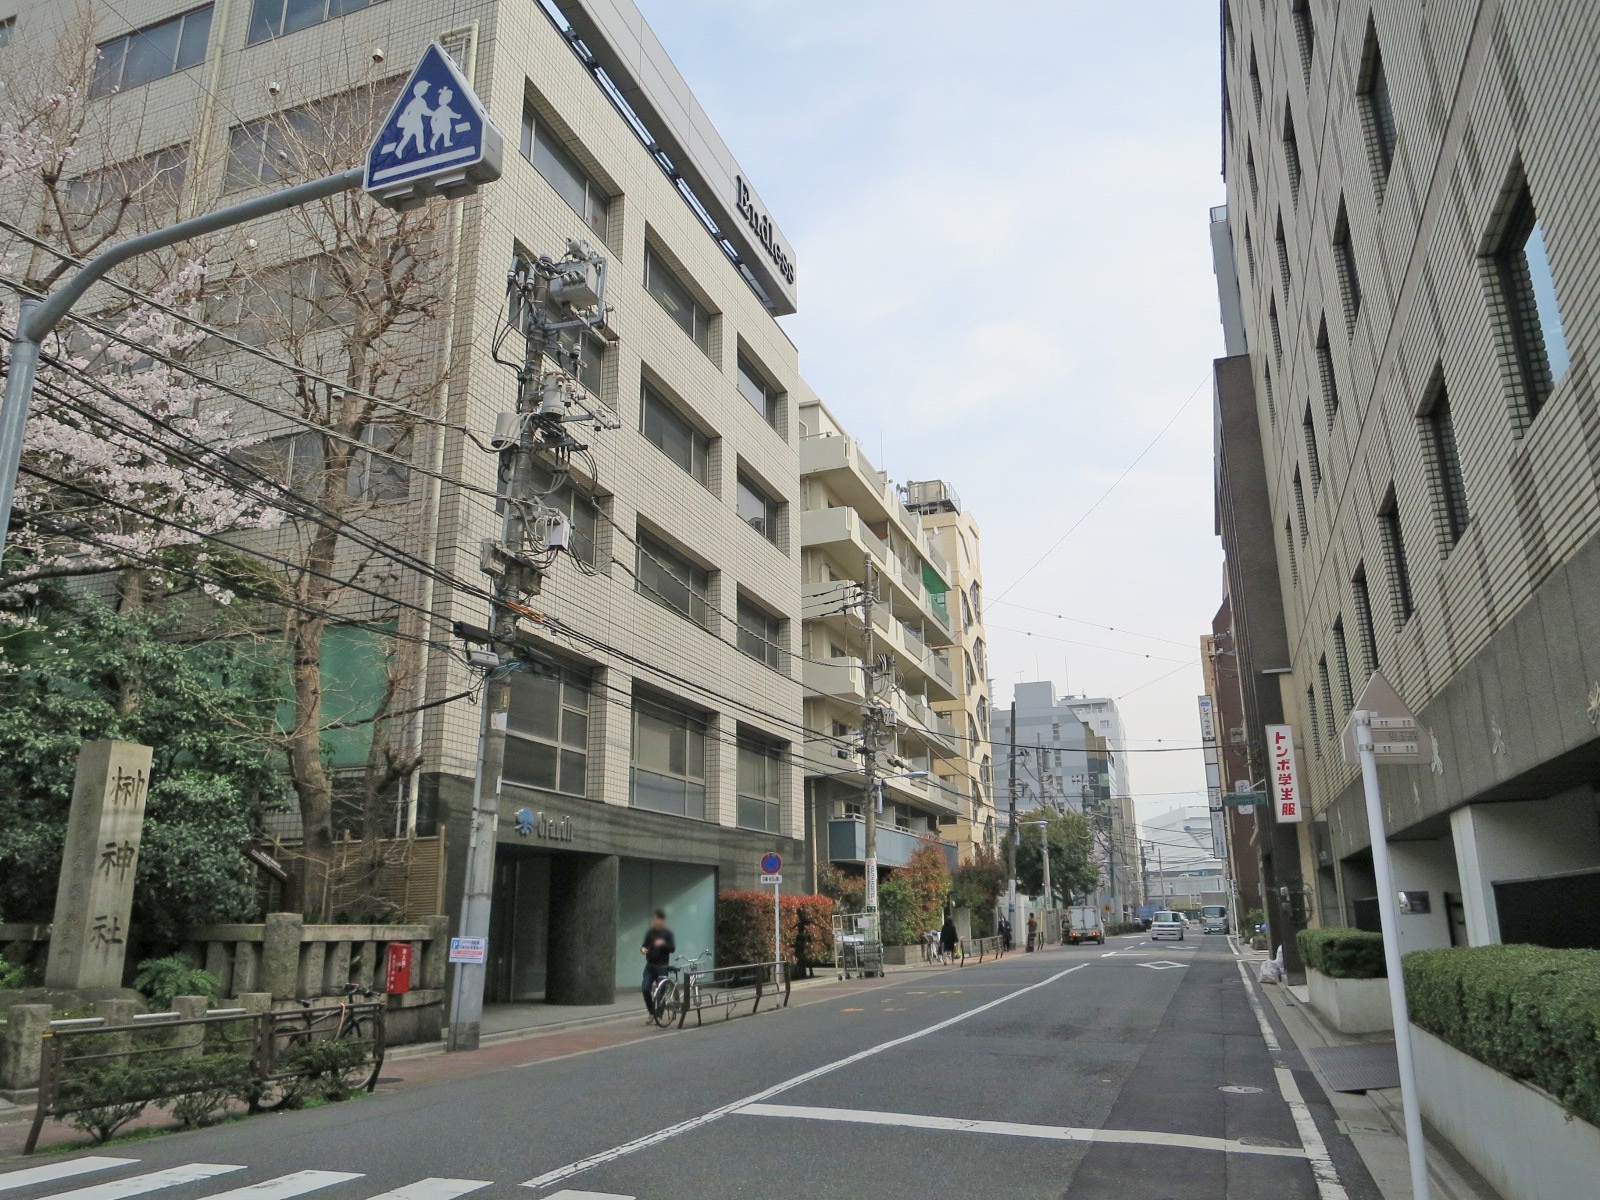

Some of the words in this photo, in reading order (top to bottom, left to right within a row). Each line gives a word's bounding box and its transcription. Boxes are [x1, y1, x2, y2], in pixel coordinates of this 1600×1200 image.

[736, 174, 794, 285] Endless
[1275, 731, 1296, 816] トンボ学生服
[89, 765, 146, 949] 榊神社
